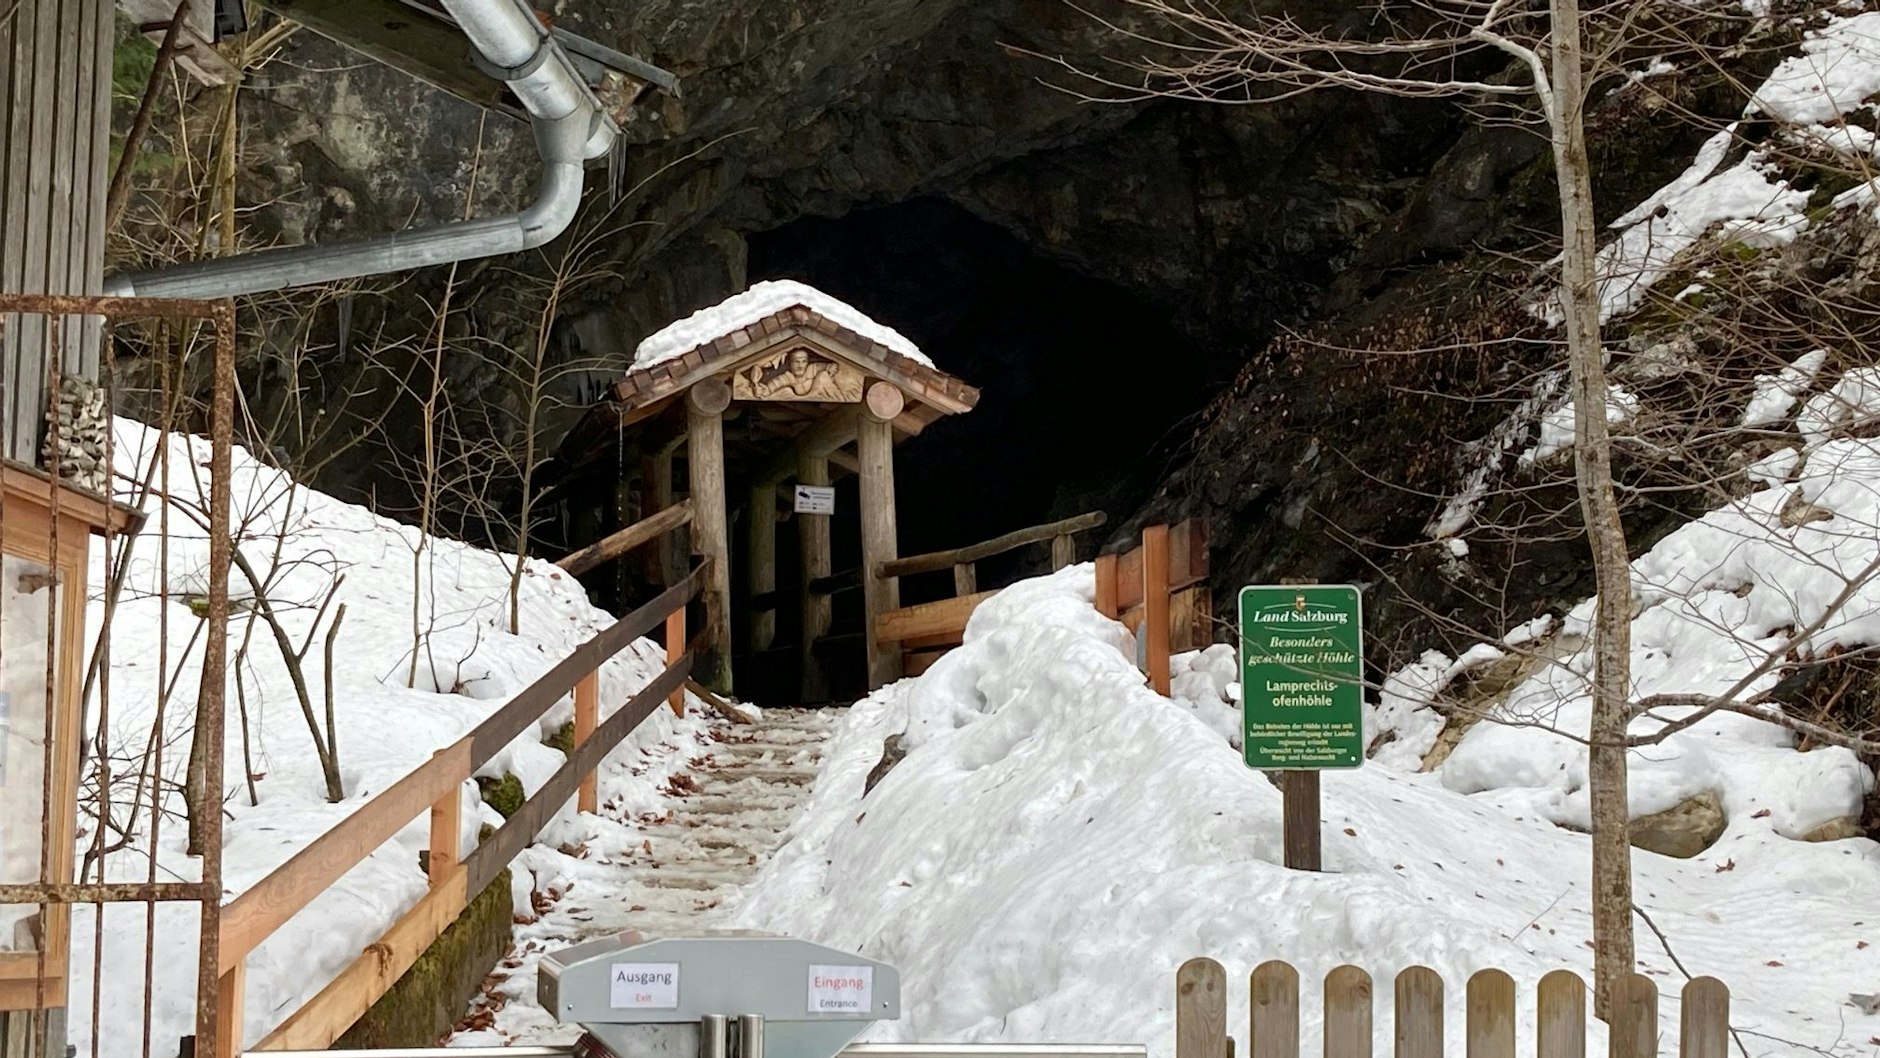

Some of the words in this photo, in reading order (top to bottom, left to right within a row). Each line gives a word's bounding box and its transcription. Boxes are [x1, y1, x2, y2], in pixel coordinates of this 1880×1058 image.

[1254, 610, 1290, 623] Land
[1291, 610, 1348, 624] Salzburg
[1270, 636, 1333, 647] Besonders
[1248, 652, 1315, 666] geschützte
[1317, 652, 1356, 663] Höhle
[1266, 680, 1338, 693] Lamprechts-
[1273, 695, 1333, 706] ofenhöhle
[617, 970, 672, 986] Ausgang
[814, 976, 864, 991] Eingang
[635, 993, 652, 1003] Exit
[819, 999, 858, 1009] Entrance
